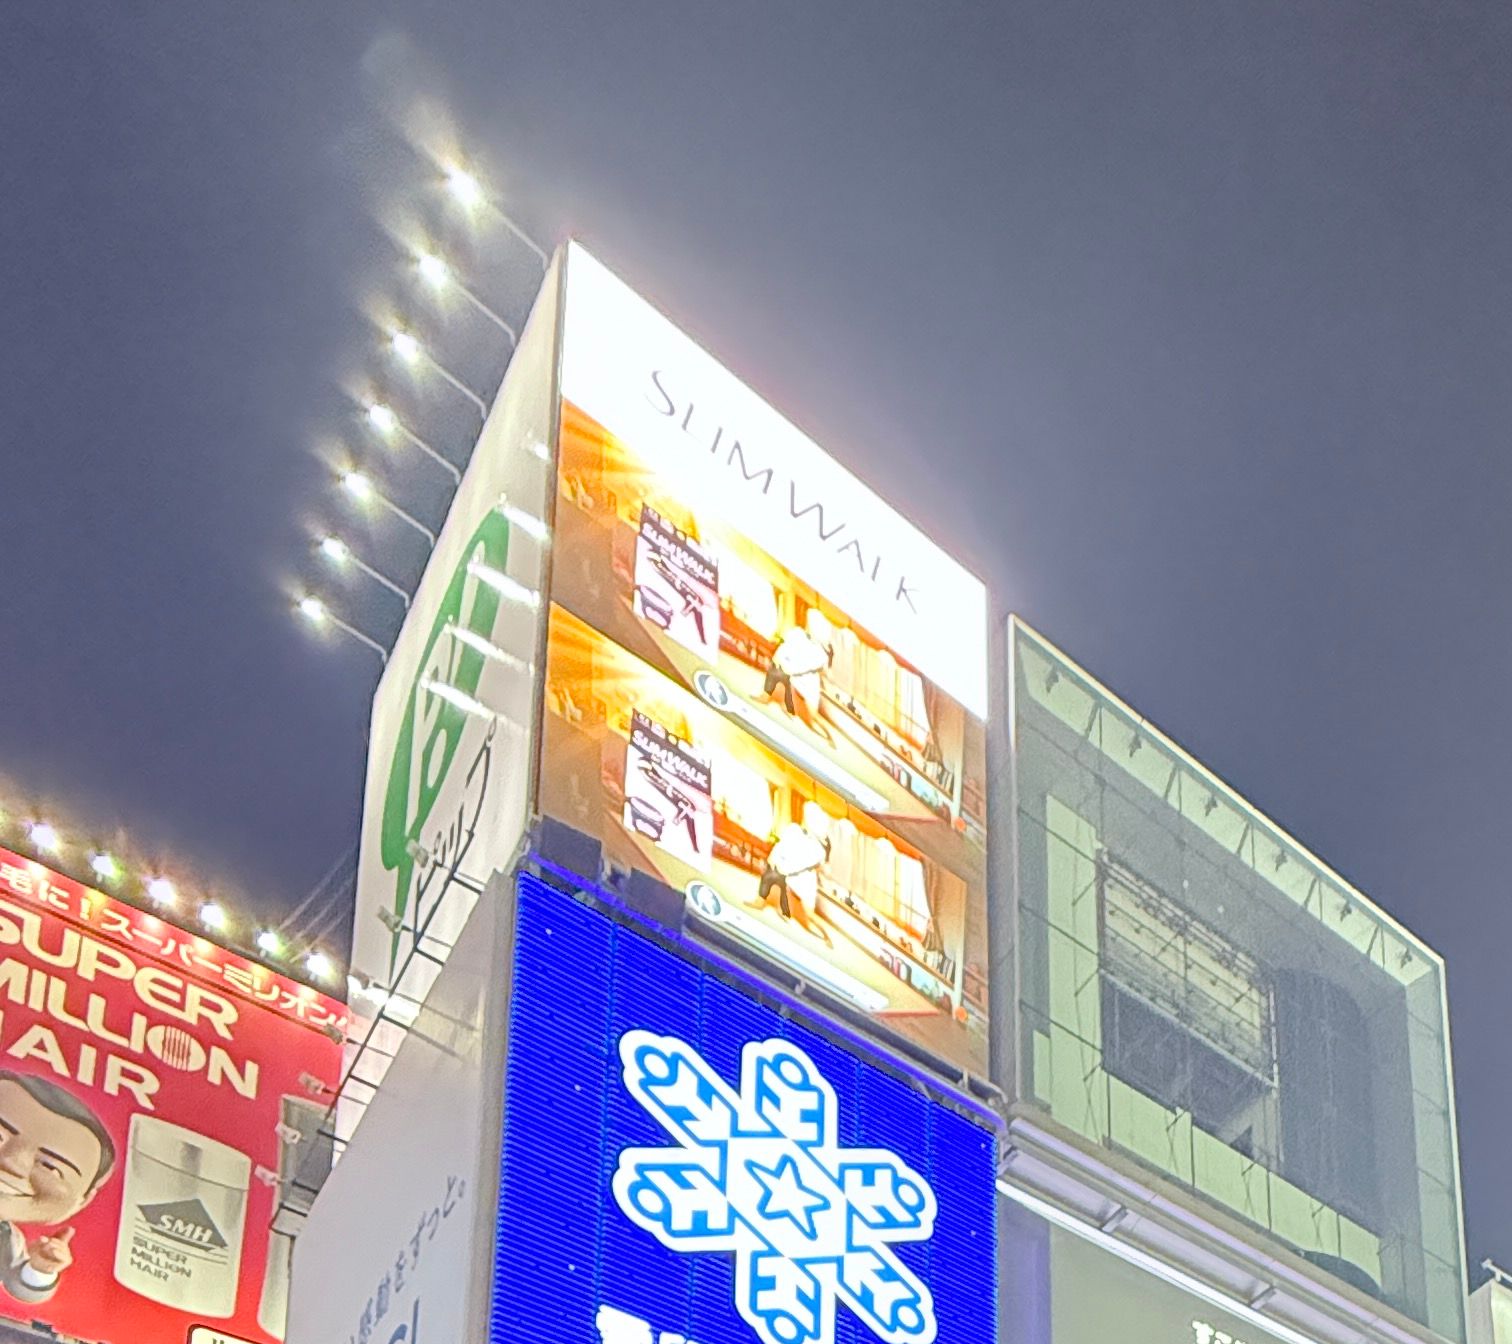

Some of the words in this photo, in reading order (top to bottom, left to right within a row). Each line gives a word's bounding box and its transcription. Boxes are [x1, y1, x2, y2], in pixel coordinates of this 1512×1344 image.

[632, 729, 708, 788] SLIMWALK
[0, 1012, 163, 1111] AIR
[160, 1214, 212, 1244] SMH
[131, 1246, 192, 1279] MILLION
[133, 1236, 188, 1266] SUPER
[129, 1257, 169, 1283] HAIR
